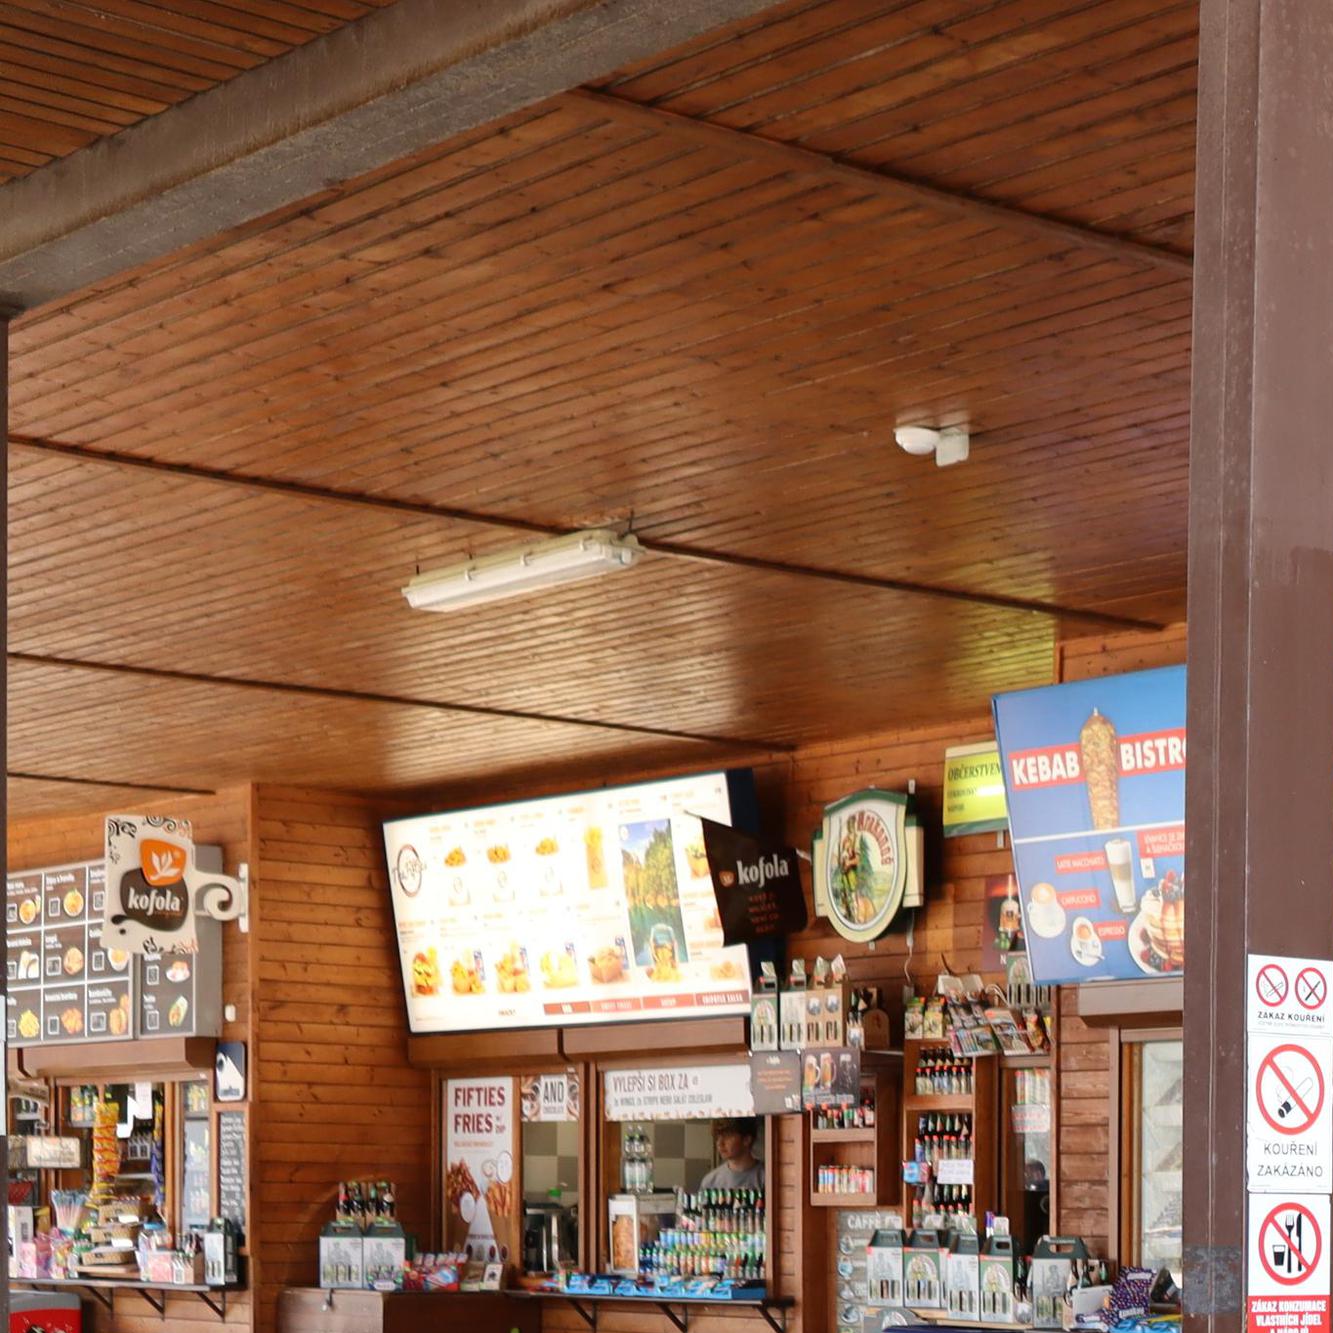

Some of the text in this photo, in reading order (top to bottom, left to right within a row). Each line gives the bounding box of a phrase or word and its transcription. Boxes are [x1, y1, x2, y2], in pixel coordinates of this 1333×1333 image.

[1011, 749, 1081, 786] KEBAB
[737, 852, 789, 890] kofola
[128, 887, 181, 916] kofola
[454, 1085, 506, 1108] FIFTIES
[543, 1080, 565, 1104] AND
[454, 1113, 494, 1135] FRIES
[1263, 1140, 1318, 1156] KOUŘENÍ
[1256, 1159, 1323, 1178] ZAKÁZÁNO
[1251, 1299, 1327, 1312] ZÁKAZ KONZUMACE
[1256, 1311, 1322, 1326] VLASTNÍCH JÍDEL
